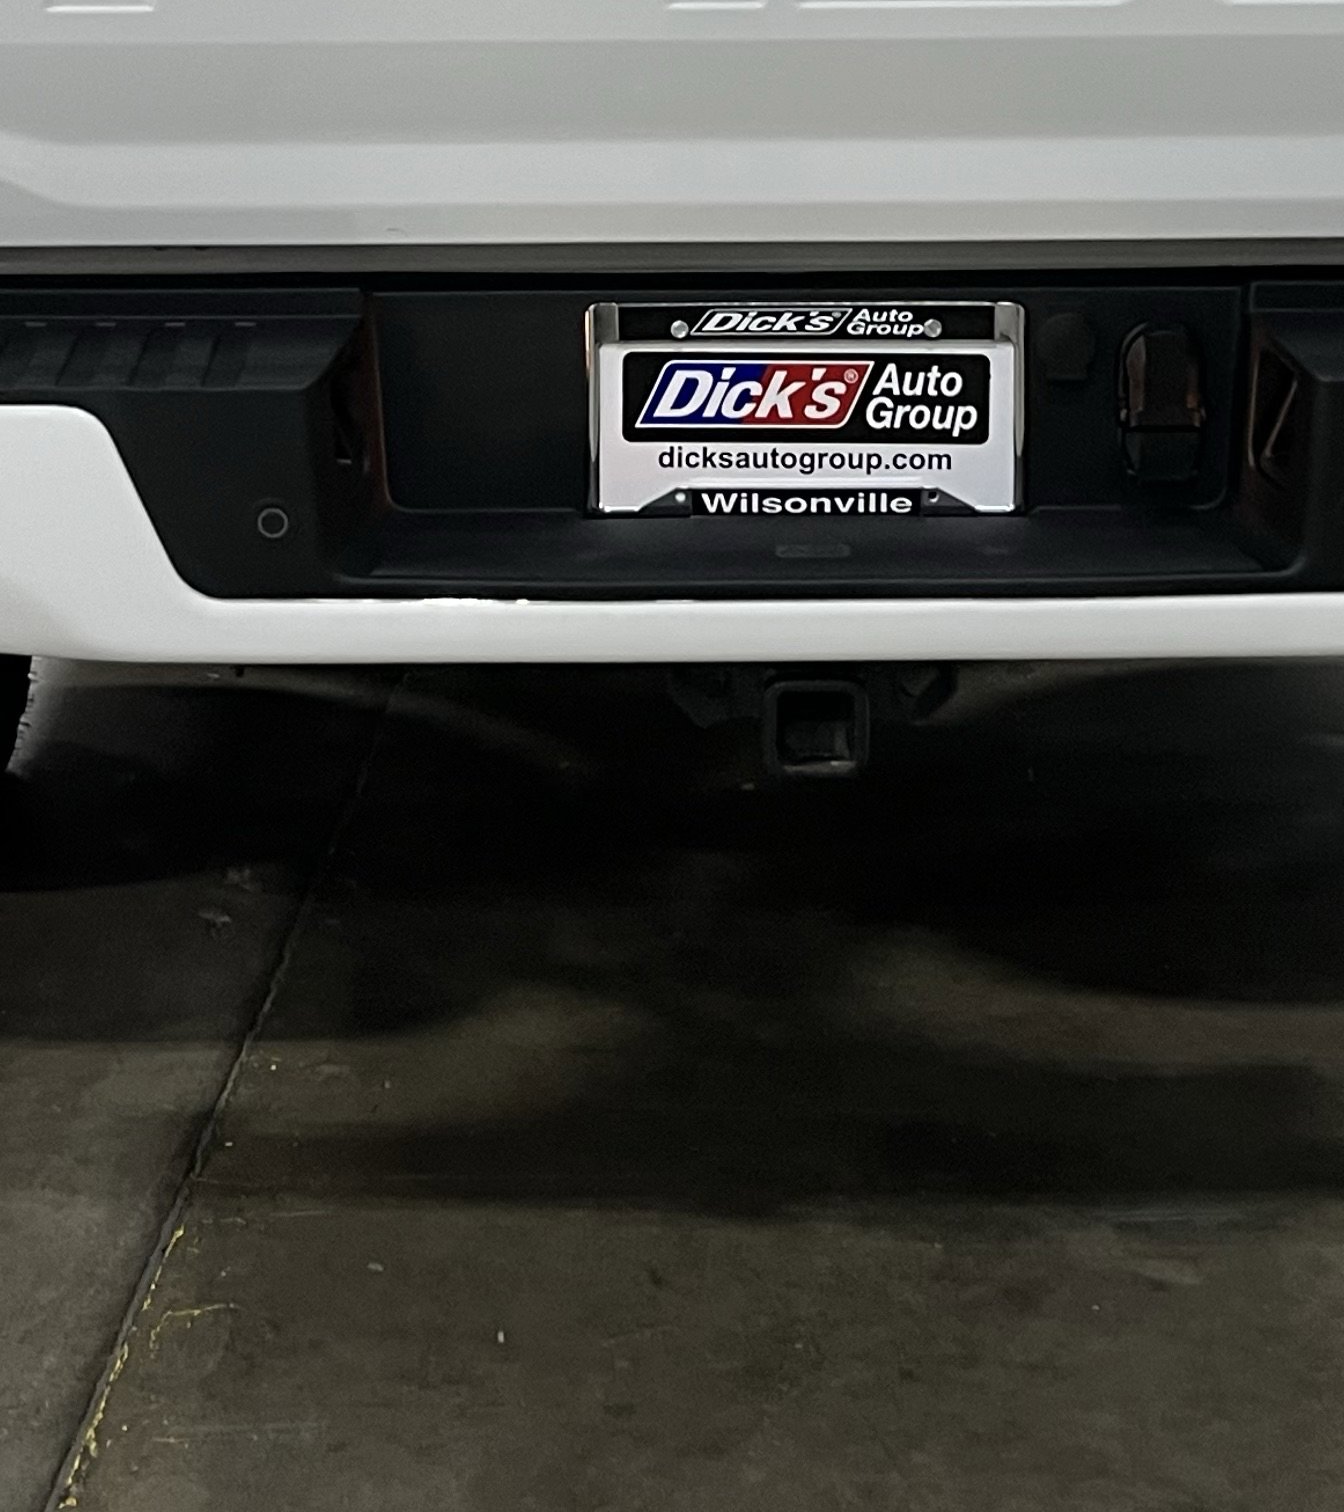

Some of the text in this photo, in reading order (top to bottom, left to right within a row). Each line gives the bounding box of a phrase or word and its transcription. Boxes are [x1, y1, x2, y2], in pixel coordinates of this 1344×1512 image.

[701, 309, 837, 333] Dick's
[852, 308, 914, 323] Auto
[846, 321, 924, 338] Group
[653, 367, 847, 420] Dick's
[872, 363, 963, 398] Auto
[865, 397, 978, 437] Group
[658, 446, 953, 475] dicksautogroup.com
[701, 492, 913, 514] Wilsonville
